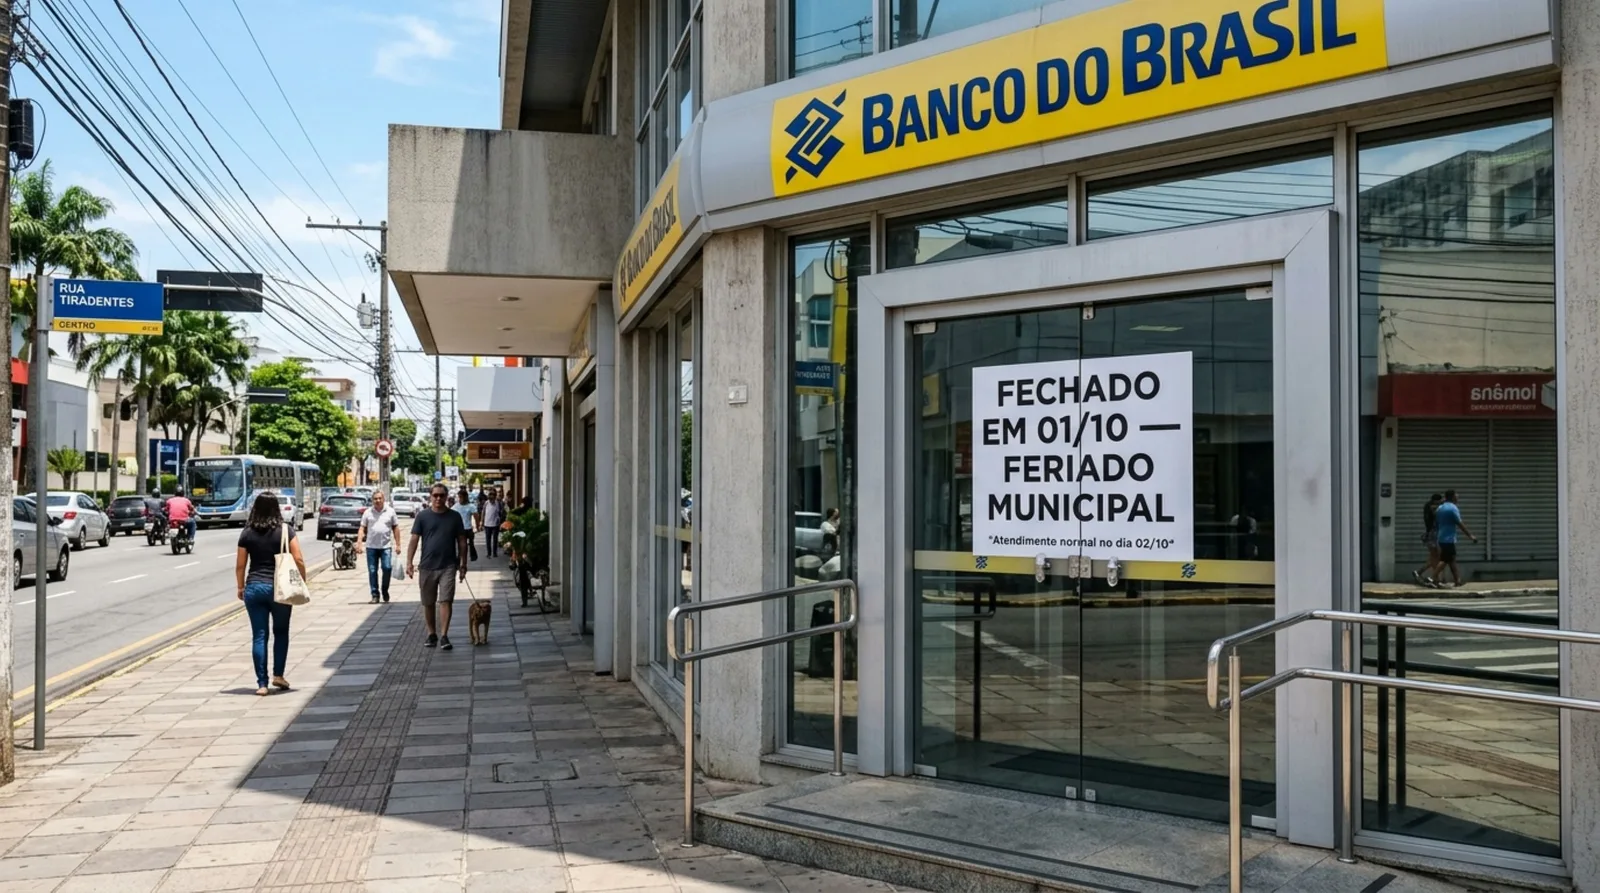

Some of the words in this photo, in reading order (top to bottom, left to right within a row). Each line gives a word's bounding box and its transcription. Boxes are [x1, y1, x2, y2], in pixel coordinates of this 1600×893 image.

[863, 66, 1026, 155] BANCO
[1037, 46, 1110, 115] DO
[1122, 0, 1357, 97] BRASIL
[59, 283, 85, 294] RUA
[59, 294, 134, 308] TIRADENTES
[998, 371, 1160, 407] FECHADO
[983, 417, 1026, 446] EM
[1037, 411, 1128, 448] 01/10
[1004, 453, 1154, 483] FERIADO
[988, 493, 1175, 523] MUNICIPAL
[1059, 537, 1096, 548] normal
[1099, 539, 1113, 548] no
[1115, 537, 1132, 548] dia
